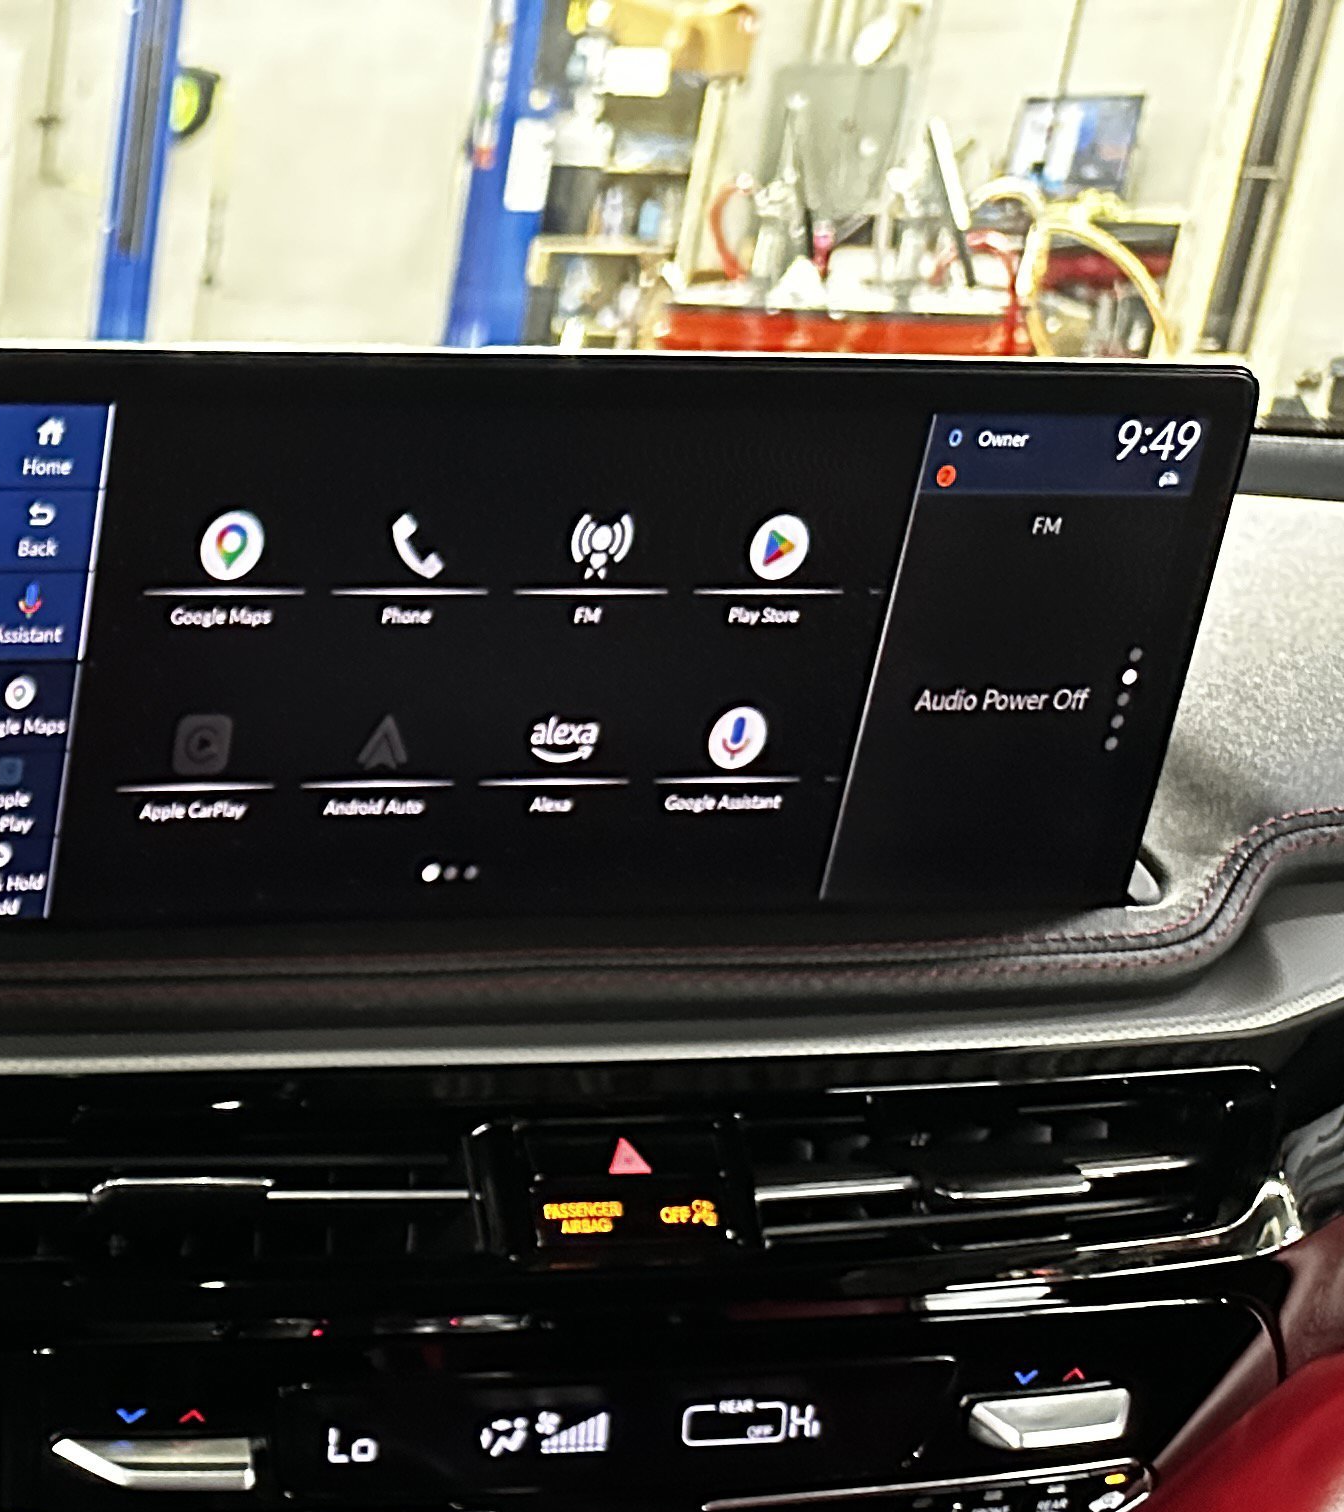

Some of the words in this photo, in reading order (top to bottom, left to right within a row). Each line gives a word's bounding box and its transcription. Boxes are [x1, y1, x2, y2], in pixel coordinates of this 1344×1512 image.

[978, 430, 1030, 448] Owner
[1116, 419, 1203, 461] 9:49
[22, 458, 73, 477] Home
[1031, 516, 1063, 535] FM
[17, 539, 59, 558] Back
[170, 608, 226, 629] Google
[228, 607, 273, 628] Maps
[381, 606, 433, 625] Phone
[573, 607, 602, 624] FM
[727, 607, 760, 627] Play
[762, 607, 800, 624] Store
[915, 688, 977, 712] Audio
[982, 688, 1048, 711] Power
[1052, 686, 1091, 711] Off
[23, 717, 67, 738] Maps
[530, 715, 600, 748] alexa
[139, 802, 186, 823] Apple
[188, 801, 248, 822] CarPlay
[322, 798, 383, 816] Android
[385, 798, 426, 816] Auto
[529, 796, 573, 813] Alexa
[665, 795, 714, 813] Google
[715, 794, 783, 811] Assistant
[6, 873, 46, 891] Hold
[543, 1201, 624, 1220] PASSENGER
[660, 1206, 691, 1224] OFF
[561, 1217, 614, 1234] AIRBAG
[718, 1398, 755, 1414] REAR
[326, 1426, 380, 1465] Lo
